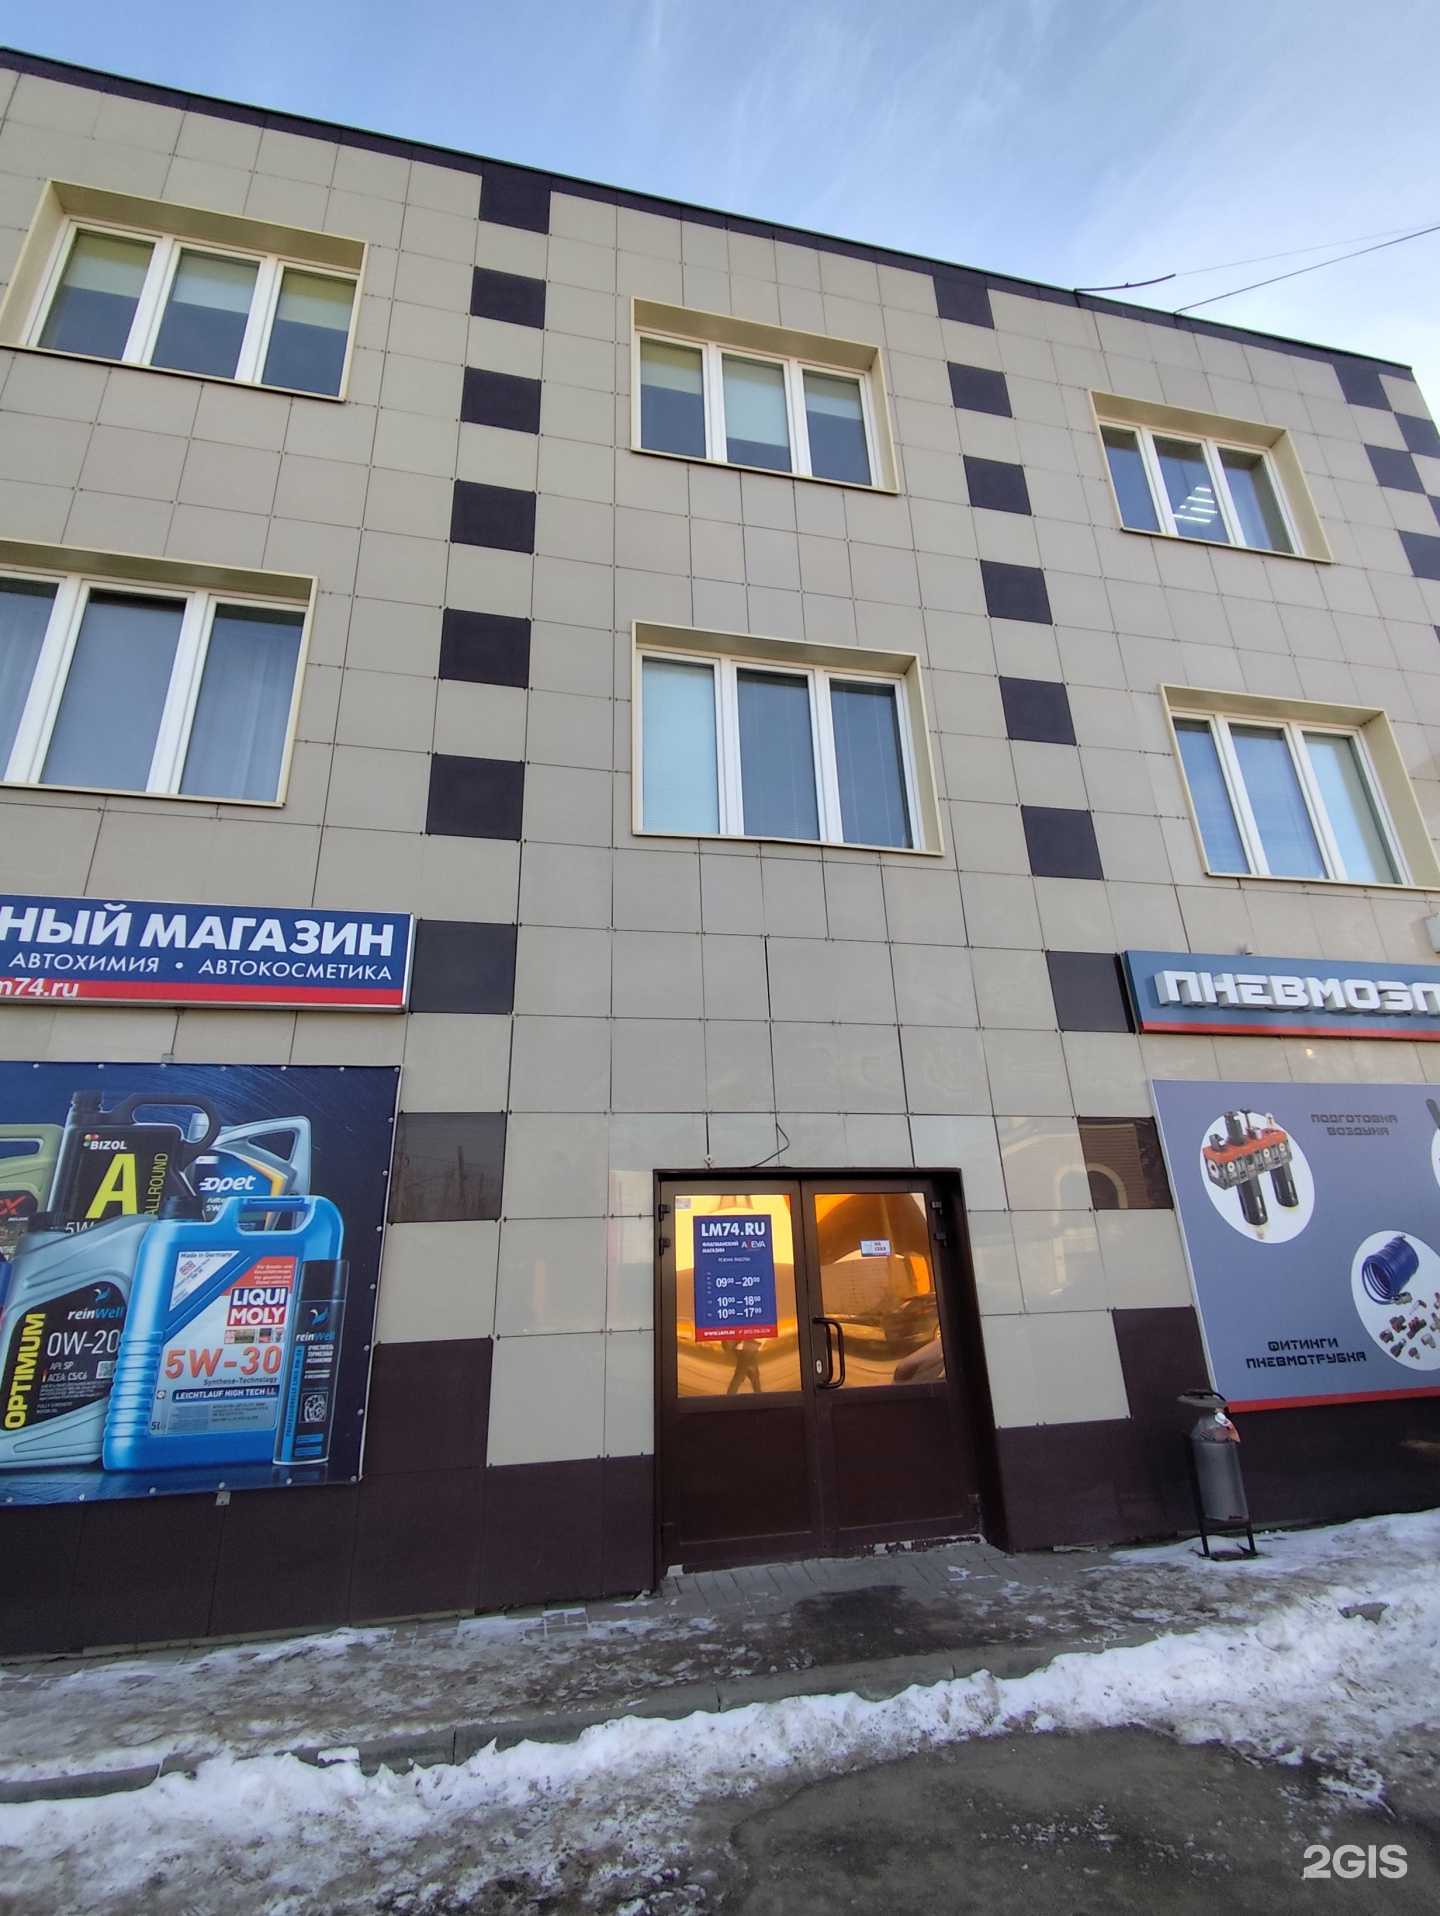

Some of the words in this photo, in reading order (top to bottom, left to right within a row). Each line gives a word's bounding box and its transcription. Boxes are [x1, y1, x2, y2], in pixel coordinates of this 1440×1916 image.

[139, 913, 394, 957] МАГАЗИН
[8, 951, 160, 974] АВТОХИМИЯ
[198, 959, 392, 981] АВТОКОСМЕТИКА
[90, 1140, 128, 1151] BIZOL
[85, 1152, 138, 1219] A
[701, 1222, 766, 1237] LM74.RU
[231, 1288, 287, 1306] LIQUI
[229, 1307, 286, 1325] MOLY
[46, 1329, 121, 1357] 0W-20
[1267, 1337, 1339, 1352] ФИТИНГИ
[165, 1345, 283, 1379] 5W-30
[1246, 1351, 1367, 1369] ПНЕВМОТРУБКА
[4, 1312, 47, 1430] OPTIMUM
[175, 1390, 225, 1400] LEICHTLAUF
